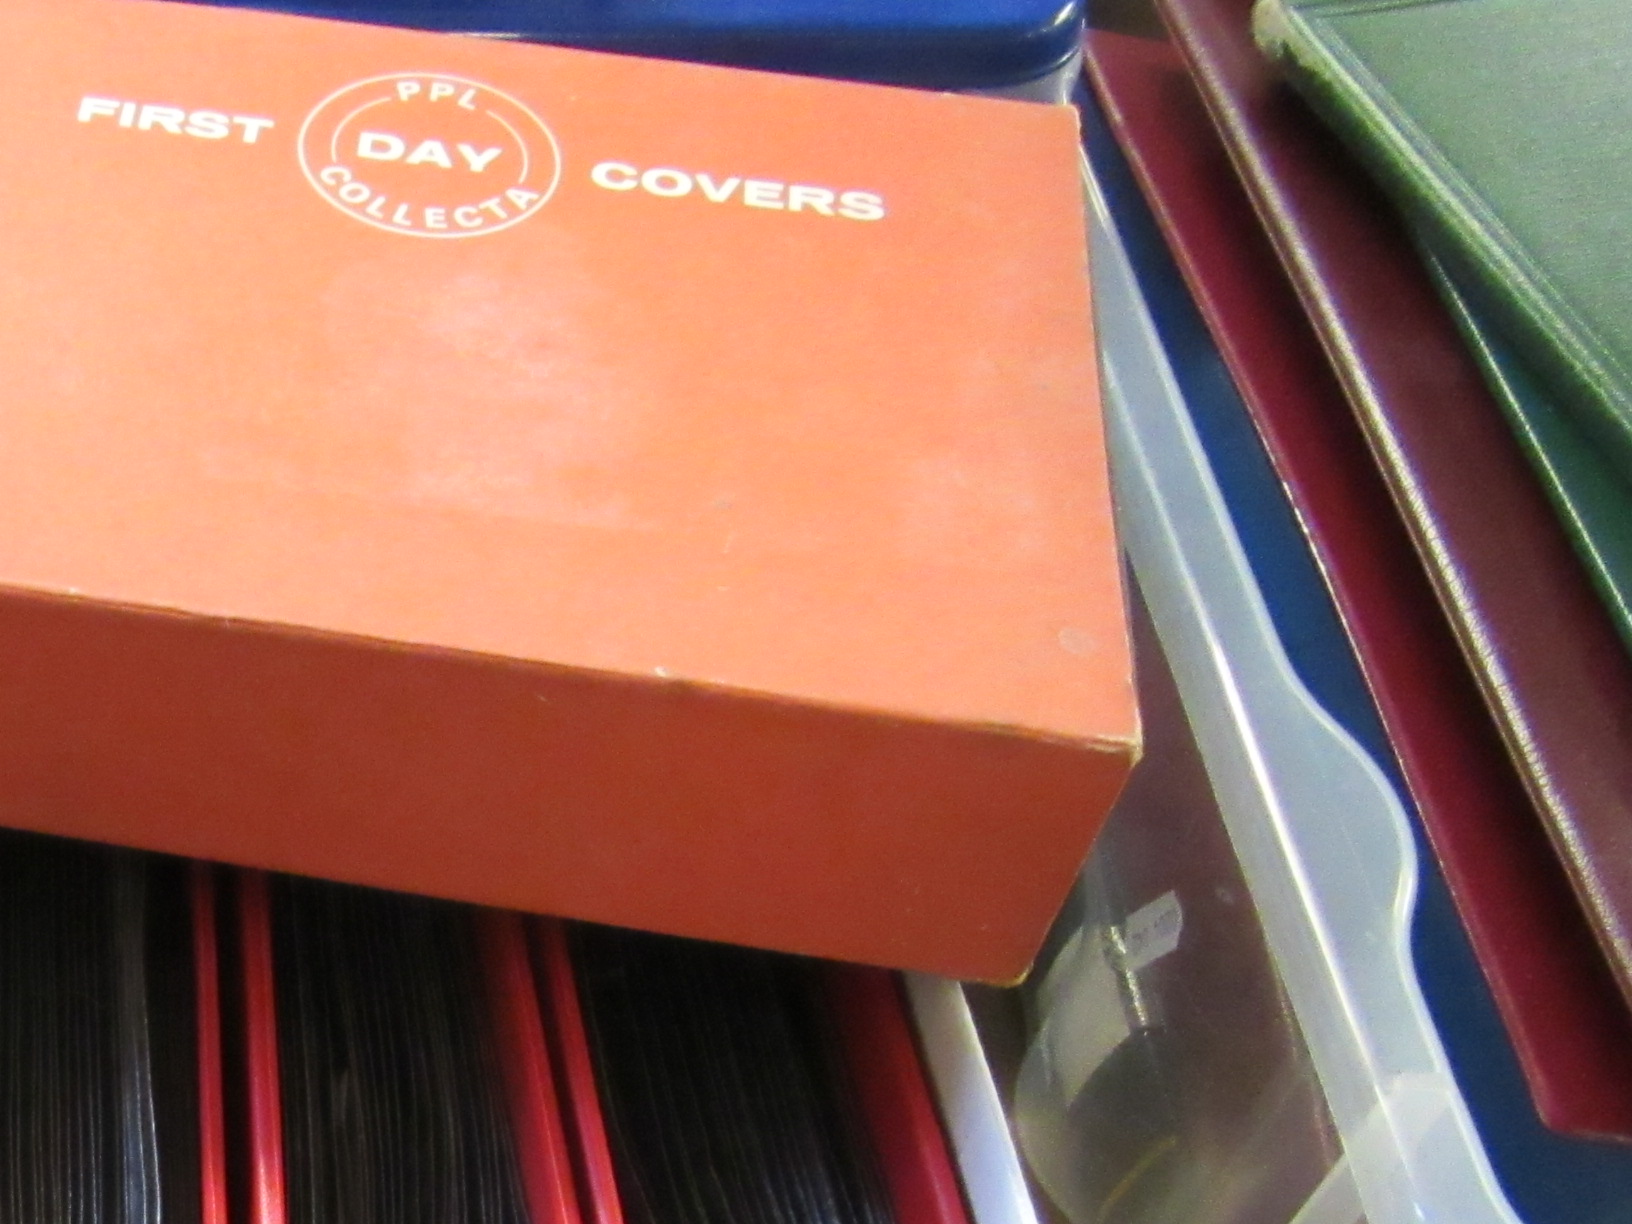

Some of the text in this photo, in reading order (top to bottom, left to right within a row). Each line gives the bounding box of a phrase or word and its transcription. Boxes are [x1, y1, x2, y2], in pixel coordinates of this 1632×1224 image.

[395, 80, 479, 113] PPL
[76, 97, 887, 221] FIRST DAY COVERS
[319, 163, 541, 230] COLLECTA
